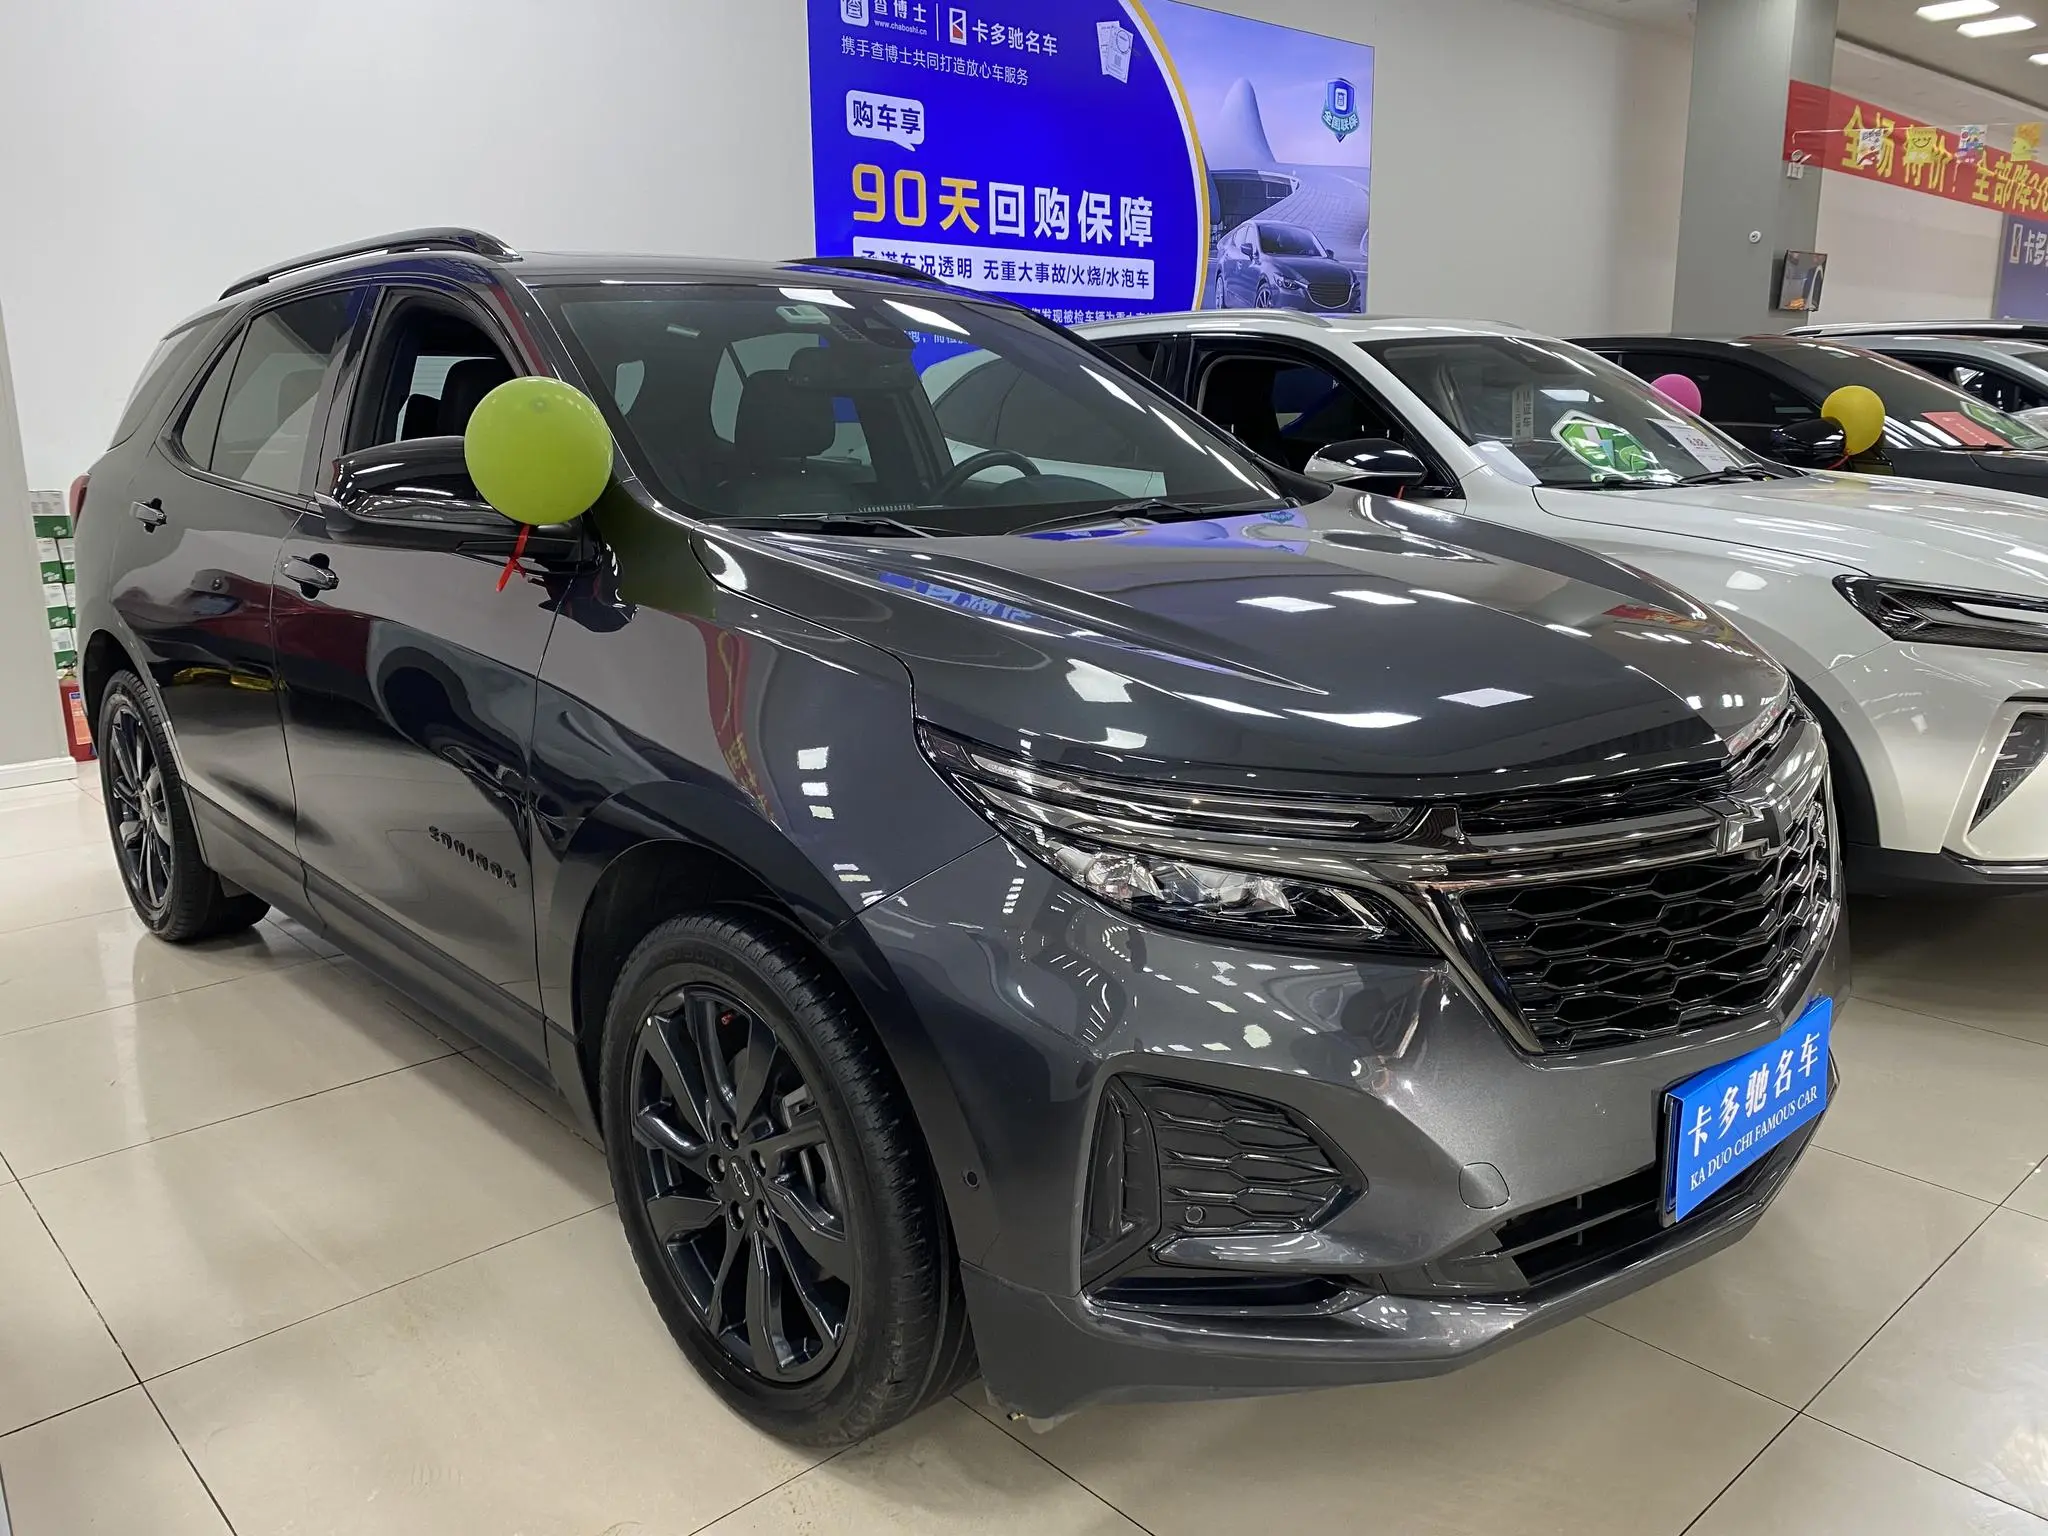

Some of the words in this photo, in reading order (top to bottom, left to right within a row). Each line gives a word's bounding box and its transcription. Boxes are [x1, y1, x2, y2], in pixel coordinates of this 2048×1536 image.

[873, 19, 928, 35] www.chaboshi.cn
[971, 19, 1059, 57] 卡多驰名车
[841, 35, 1029, 87] 携手查博士共同打造放心车服务
[851, 100, 922, 137] 购车享
[2023, 228, 2048, 267] 卡多
[984, 259, 1150, 289] 无重大事故/火烧/水泡车
[1687, 1031, 1821, 1158] 卡多驰名车
[1690, 1165, 1706, 1192] KA
[1708, 1146, 1732, 1177] DUO
[1734, 1132, 1753, 1157] CHI
[1754, 1099, 1797, 1142] FAMOUS
[1797, 1085, 1818, 1113] CAR
